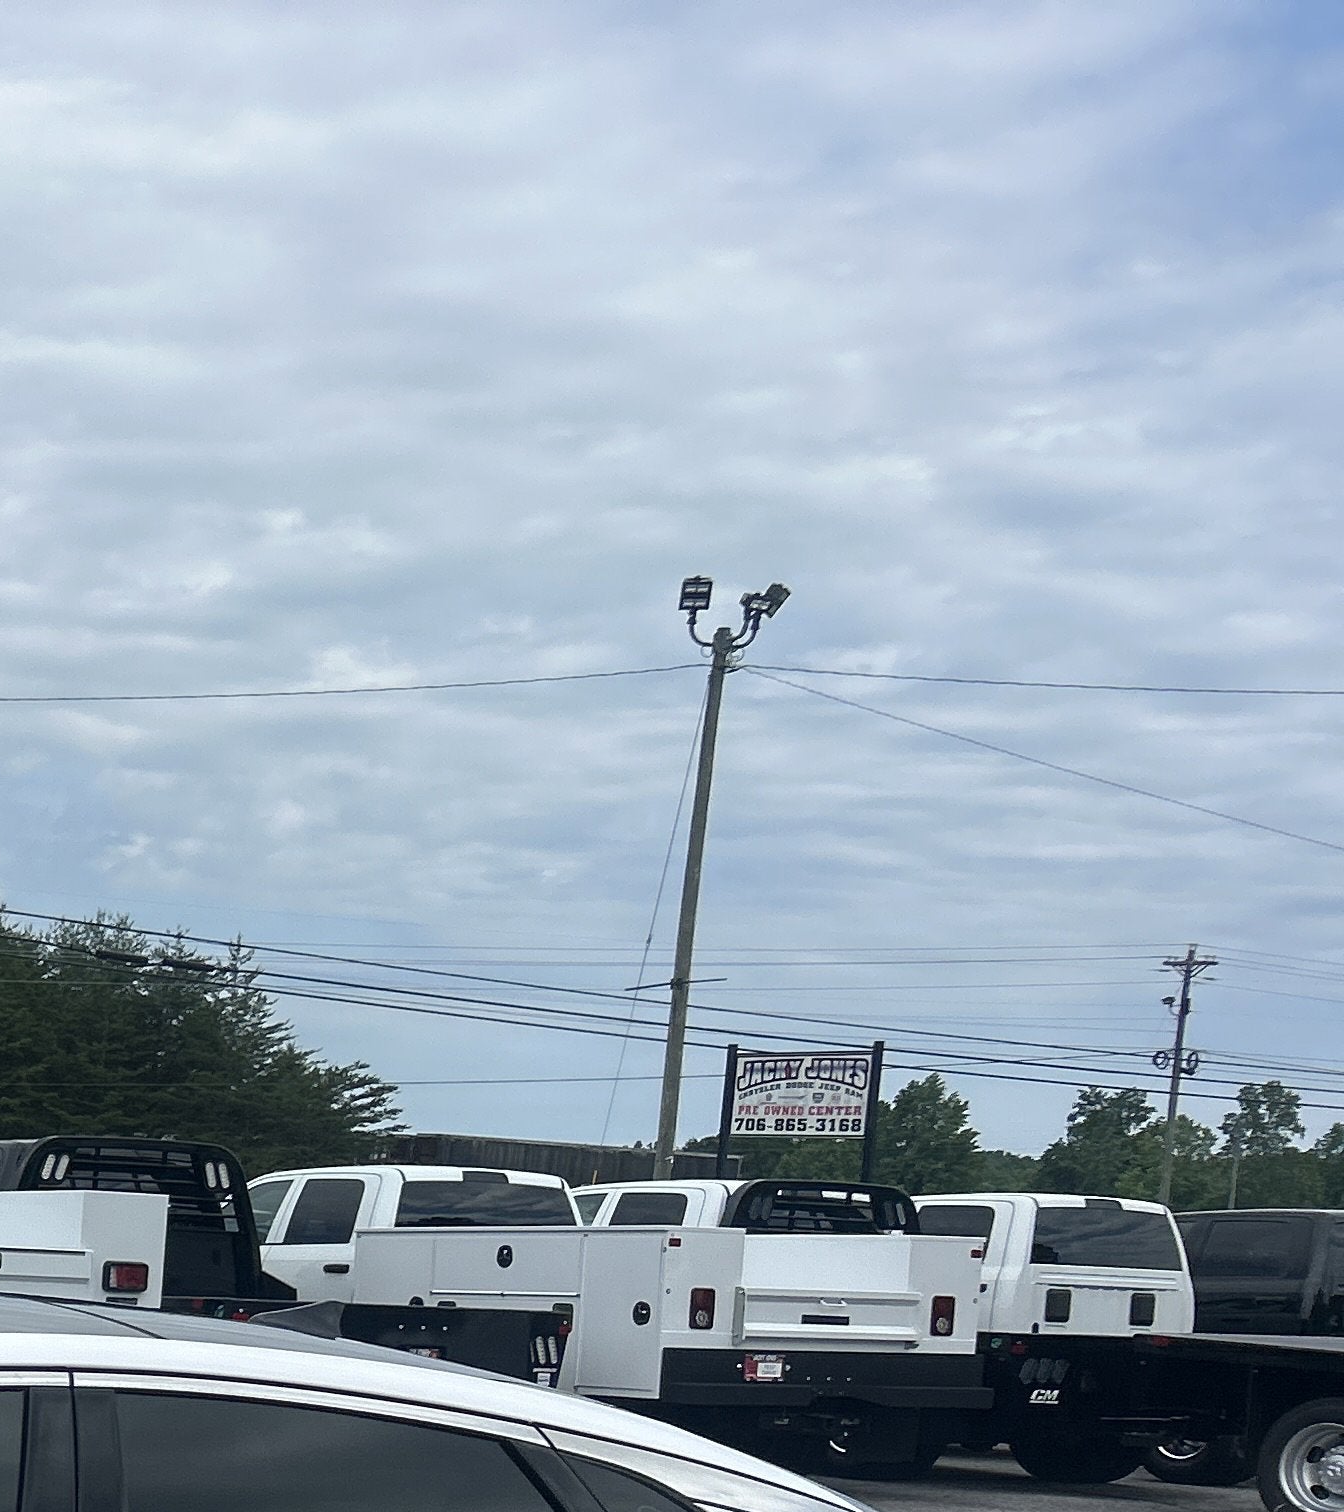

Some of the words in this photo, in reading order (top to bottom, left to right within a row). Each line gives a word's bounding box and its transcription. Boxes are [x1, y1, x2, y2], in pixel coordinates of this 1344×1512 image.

[737, 1058, 805, 1091] JACKY
[805, 1057, 869, 1090] JONES
[785, 1081, 814, 1089] DODGE
[818, 1082, 841, 1092] JEEP
[845, 1087, 863, 1099] RAM
[737, 1105, 759, 1116] PRE
[763, 1105, 804, 1116] OWNED
[808, 1105, 862, 1116] CENTER
[734, 1117, 862, 1132] 706-865-3168
[1030, 1389, 1060, 1401] CM
